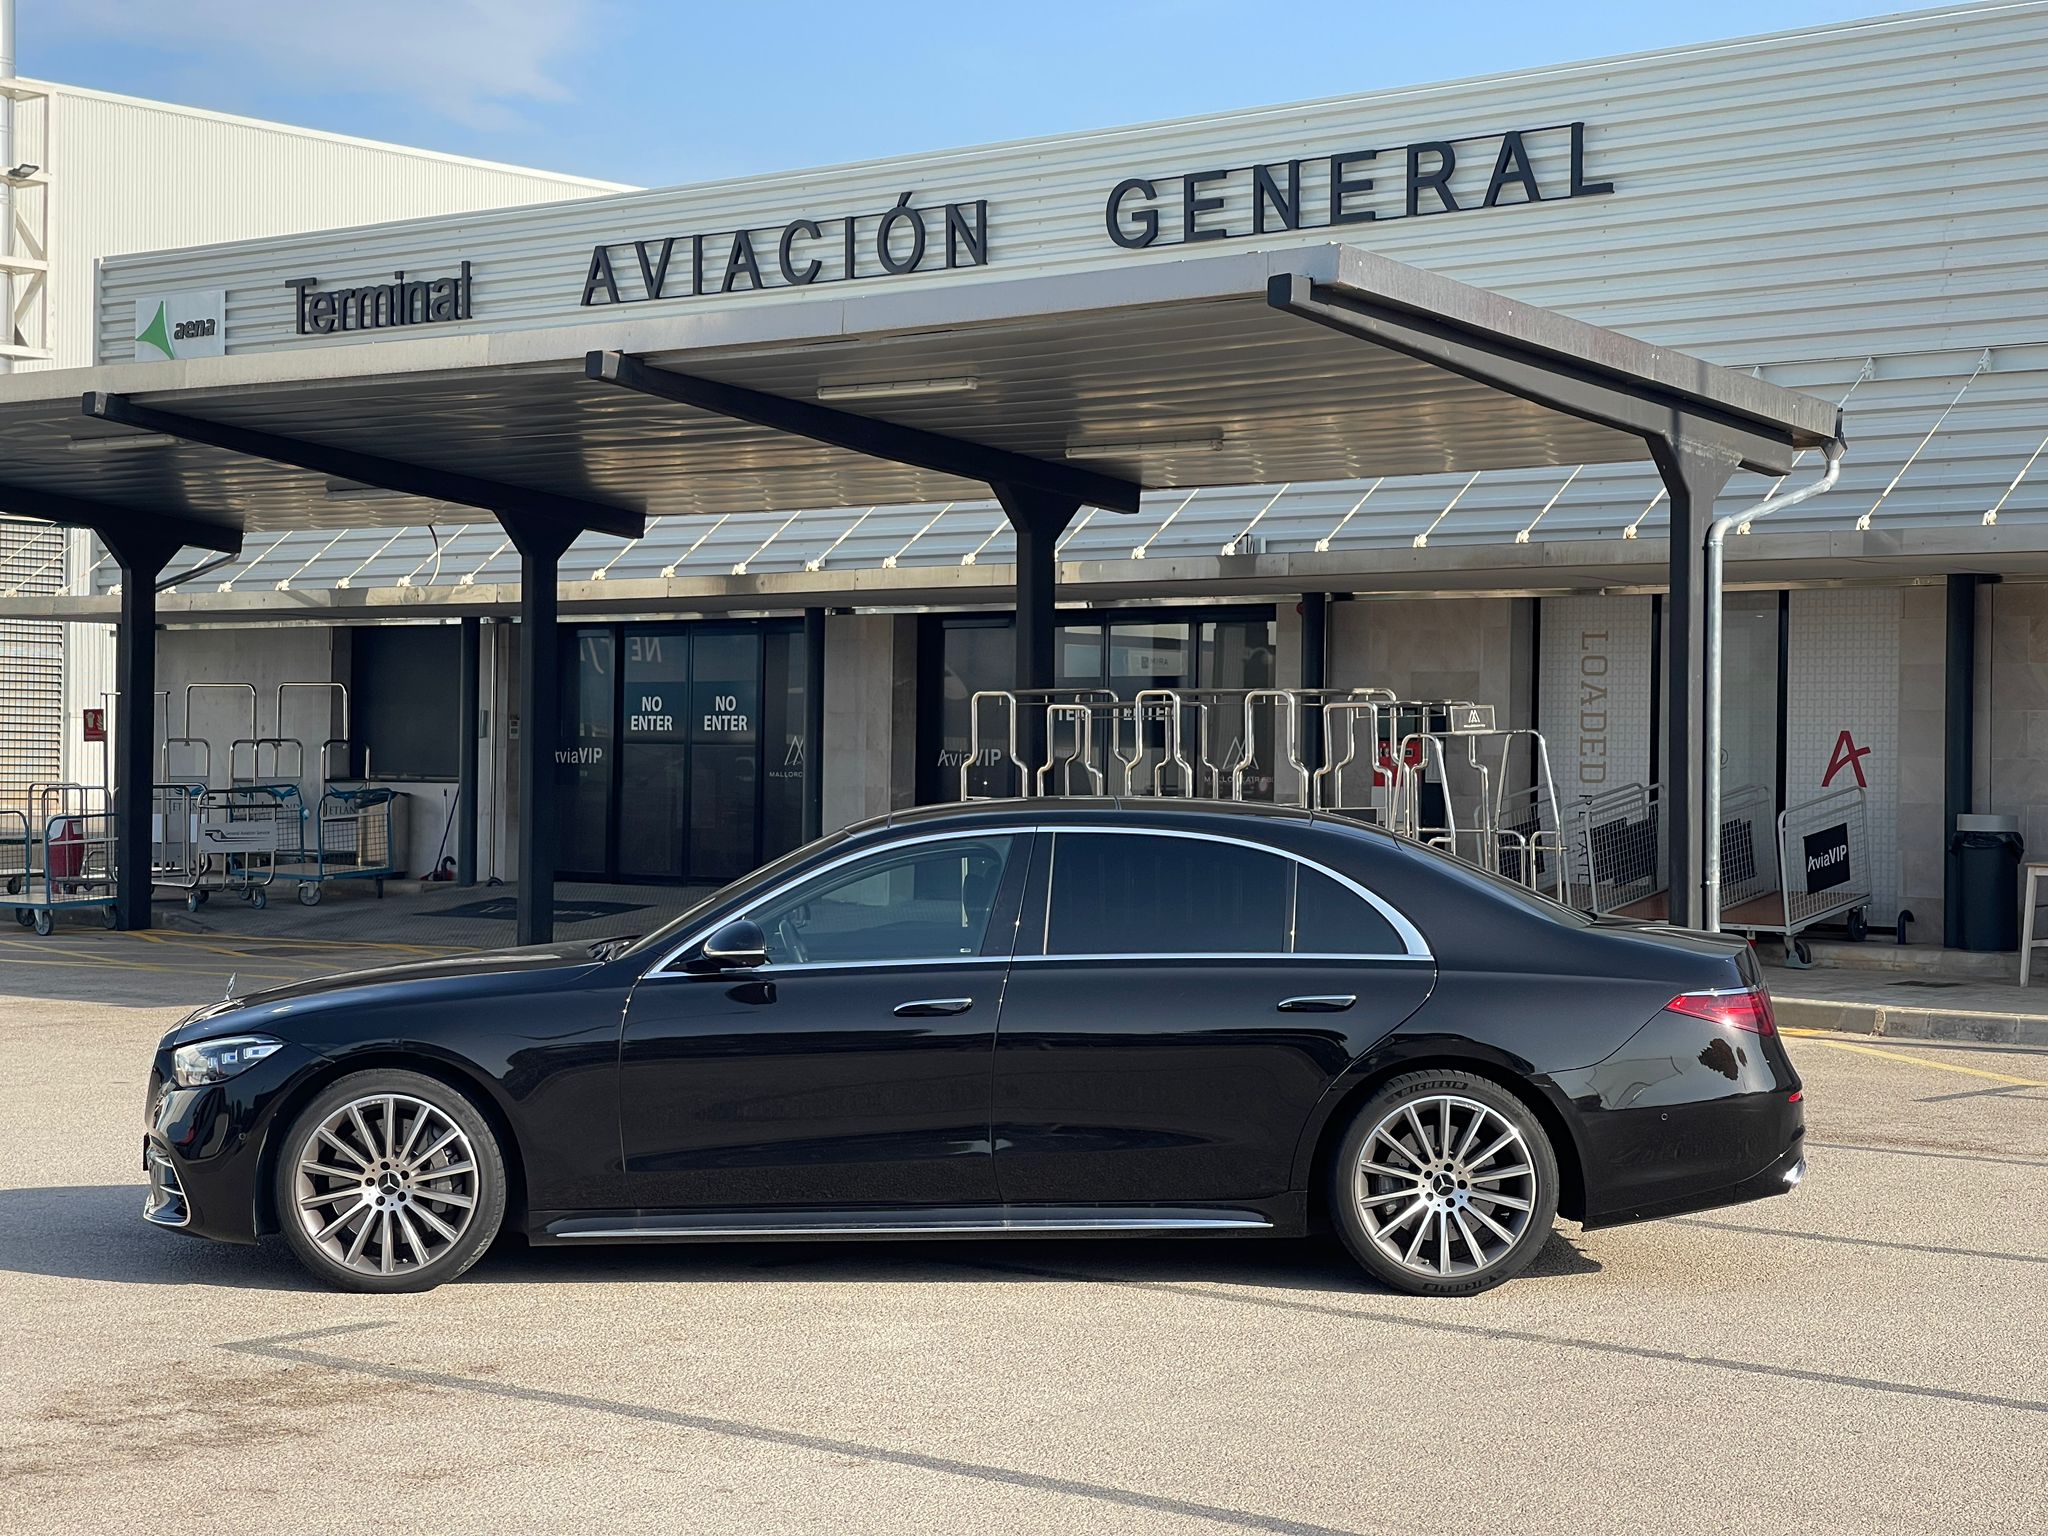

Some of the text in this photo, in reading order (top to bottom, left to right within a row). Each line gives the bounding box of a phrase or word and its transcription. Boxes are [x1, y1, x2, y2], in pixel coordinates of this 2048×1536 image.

[581, 122, 1614, 305] AVIACIÓN GENERAL
[285, 261, 472, 334] Terminal
[173, 317, 215, 340] aena
[642, 696, 662, 712] NO
[715, 696, 737, 712] NO
[1580, 631, 1608, 783] LOADED
[631, 715, 673, 731] ENTER
[704, 715, 748, 731] ENTER
[324, 801, 357, 817] JETLAN
[1807, 844, 1848, 873] AviaVIP
[1401, 1081, 1467, 1097] MICHELIN
